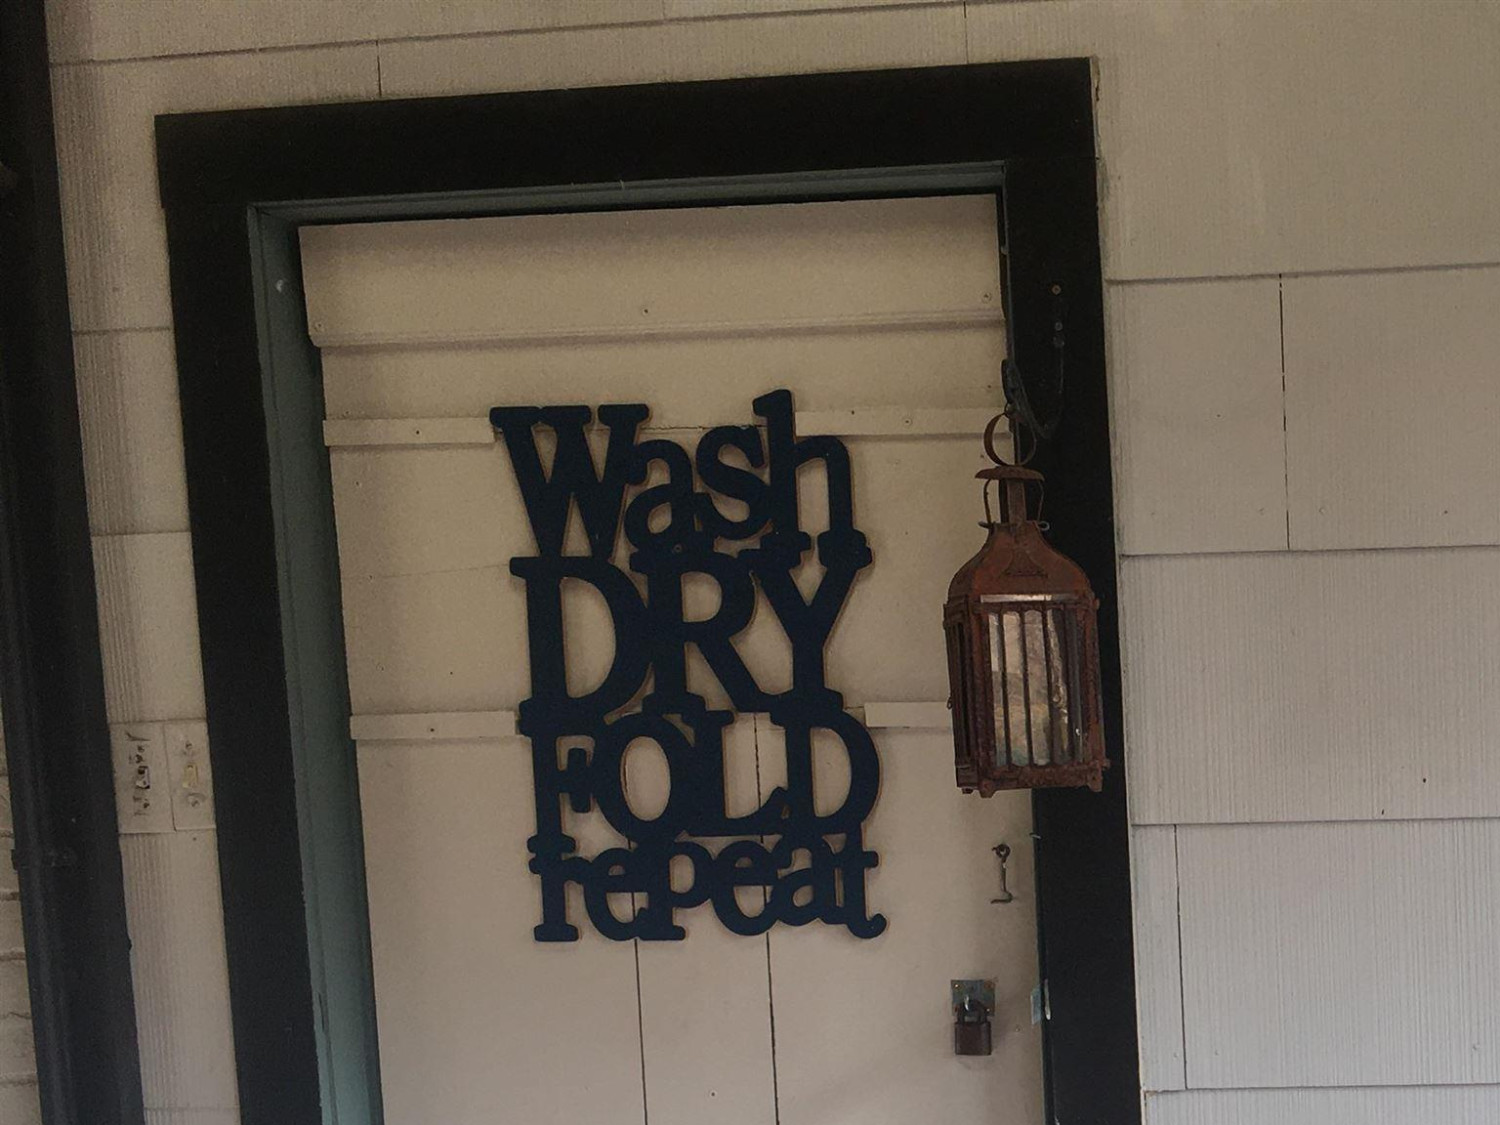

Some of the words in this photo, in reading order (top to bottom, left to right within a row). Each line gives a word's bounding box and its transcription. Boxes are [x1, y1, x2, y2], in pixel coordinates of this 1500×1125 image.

[489, 389, 867, 556] Wash
[509, 547, 872, 714] DRY
[518, 704, 880, 853] FOLD
[528, 835, 888, 941] repeat
